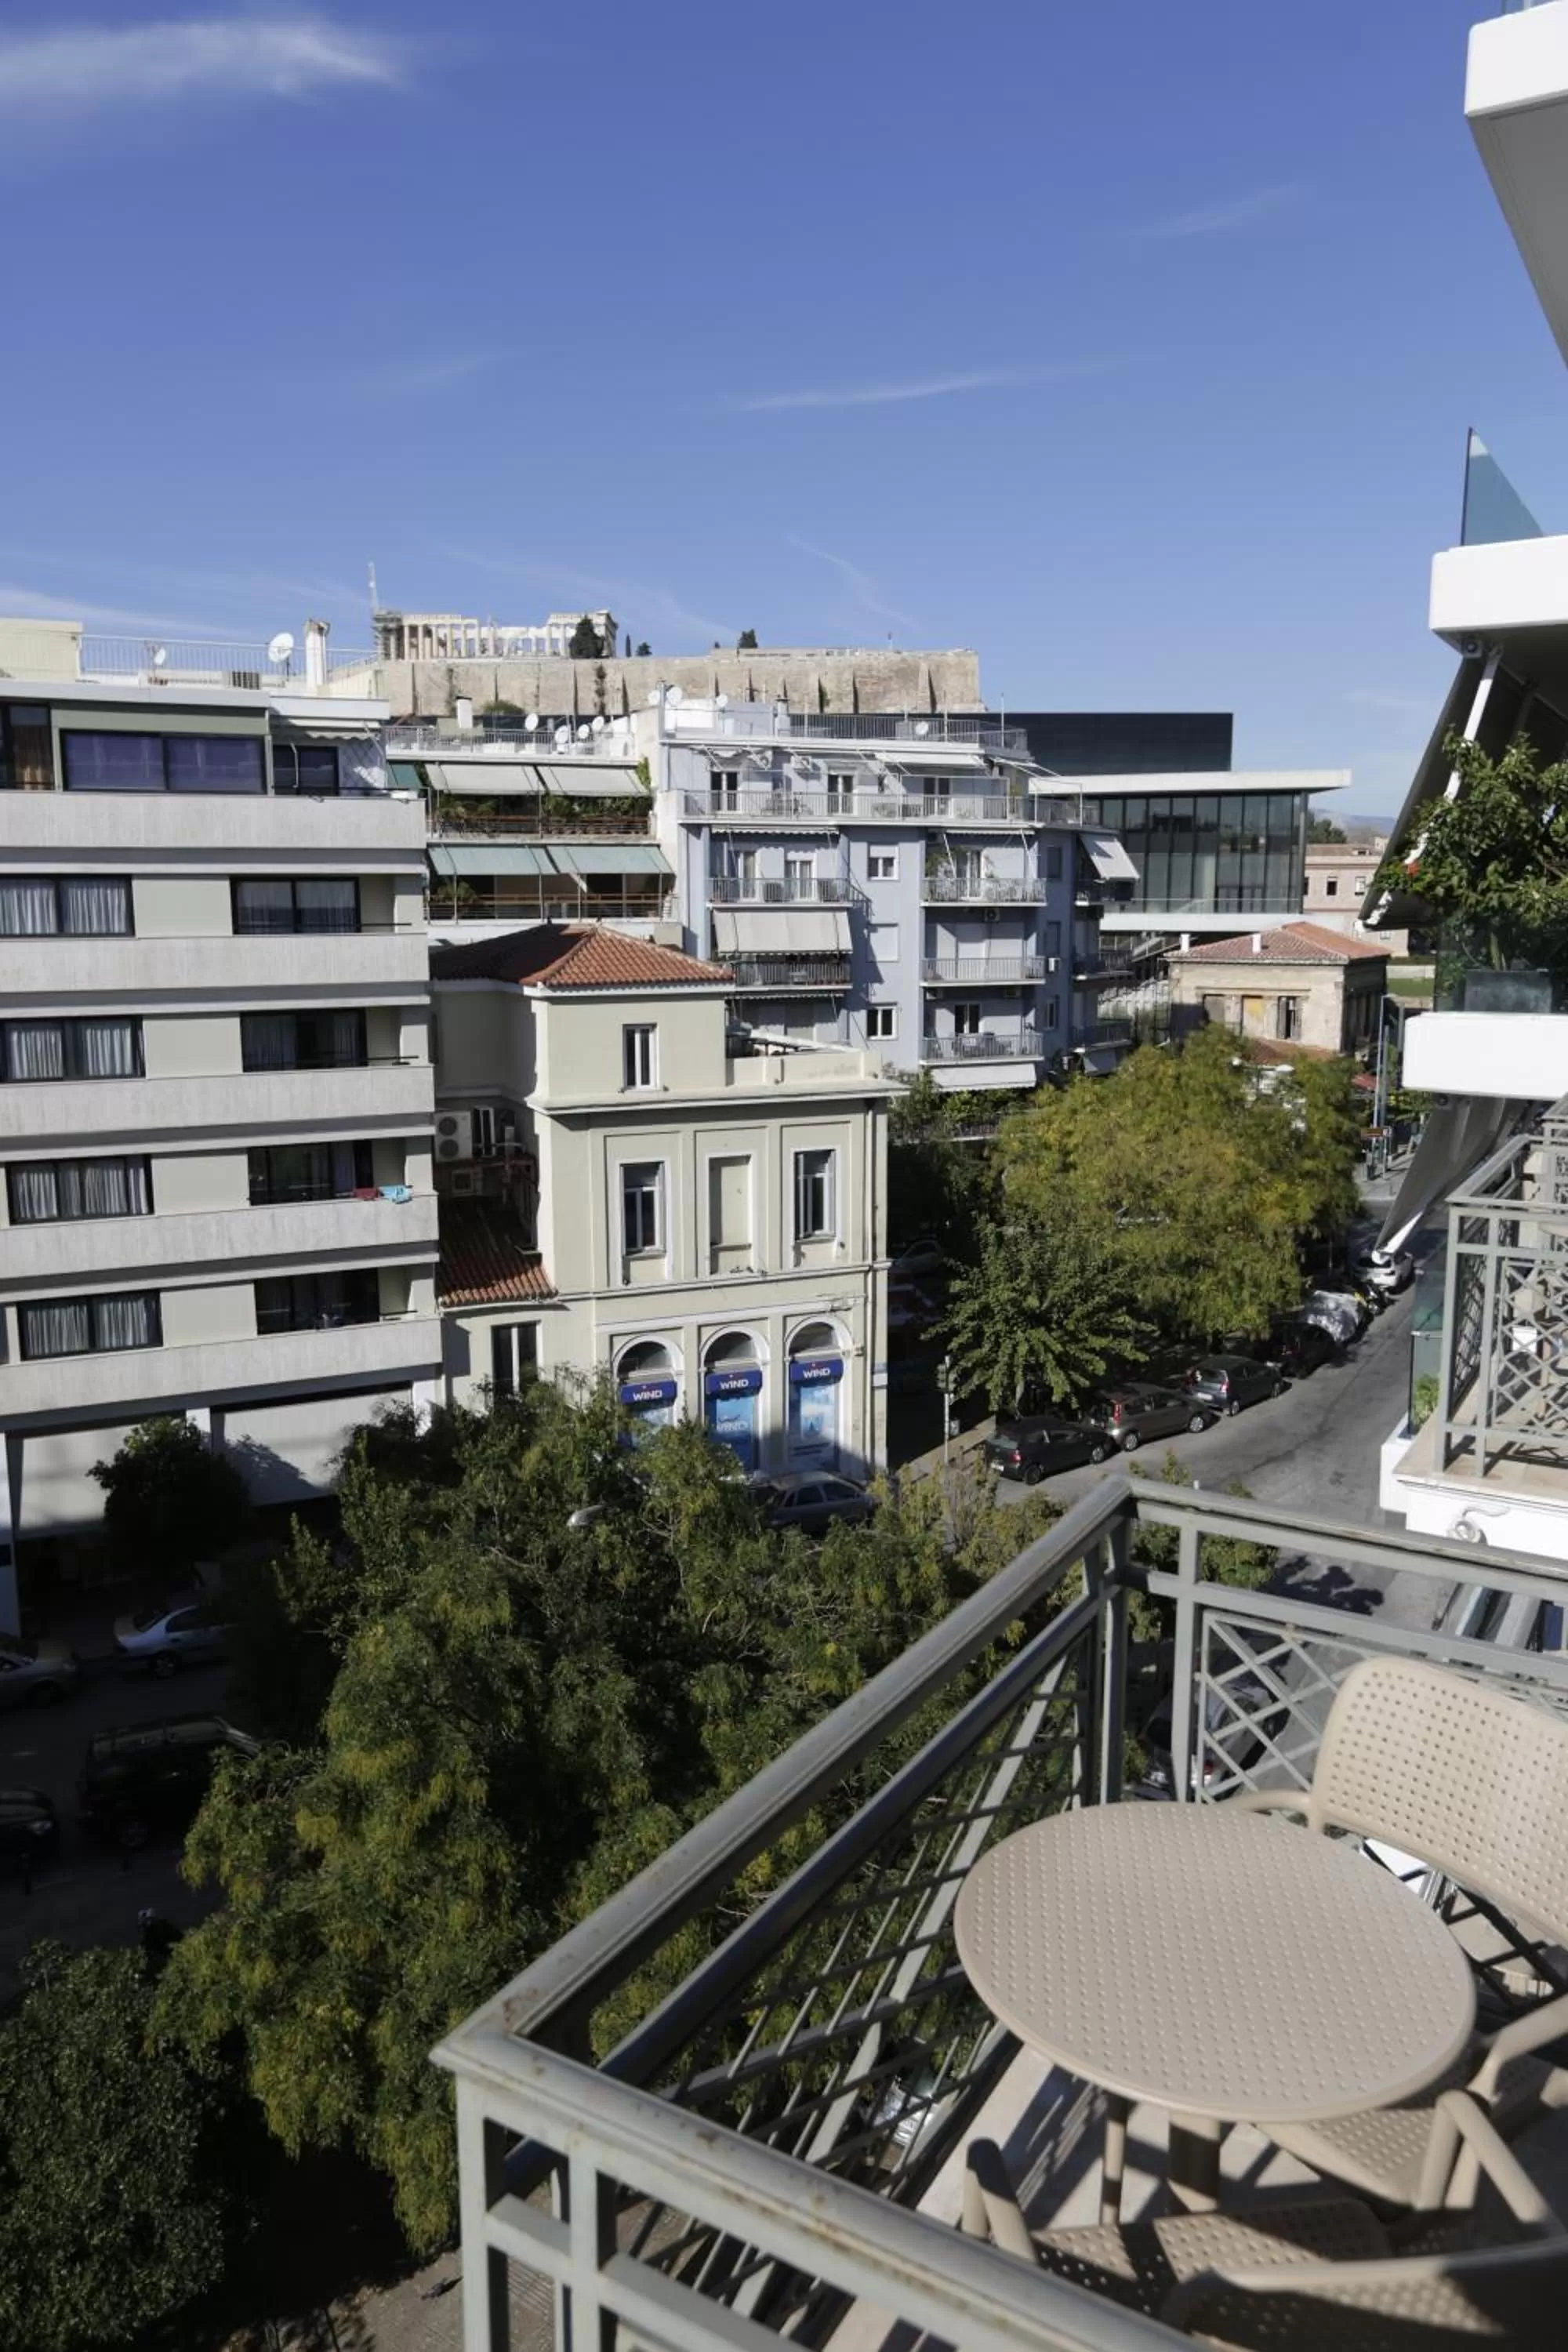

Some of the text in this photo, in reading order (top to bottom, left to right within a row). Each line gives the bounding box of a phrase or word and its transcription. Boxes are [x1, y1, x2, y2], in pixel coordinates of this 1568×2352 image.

[803, 1367, 830, 1378] WIND
[720, 1379, 749, 1389] WIND
[633, 1390, 662, 1400] WIND
